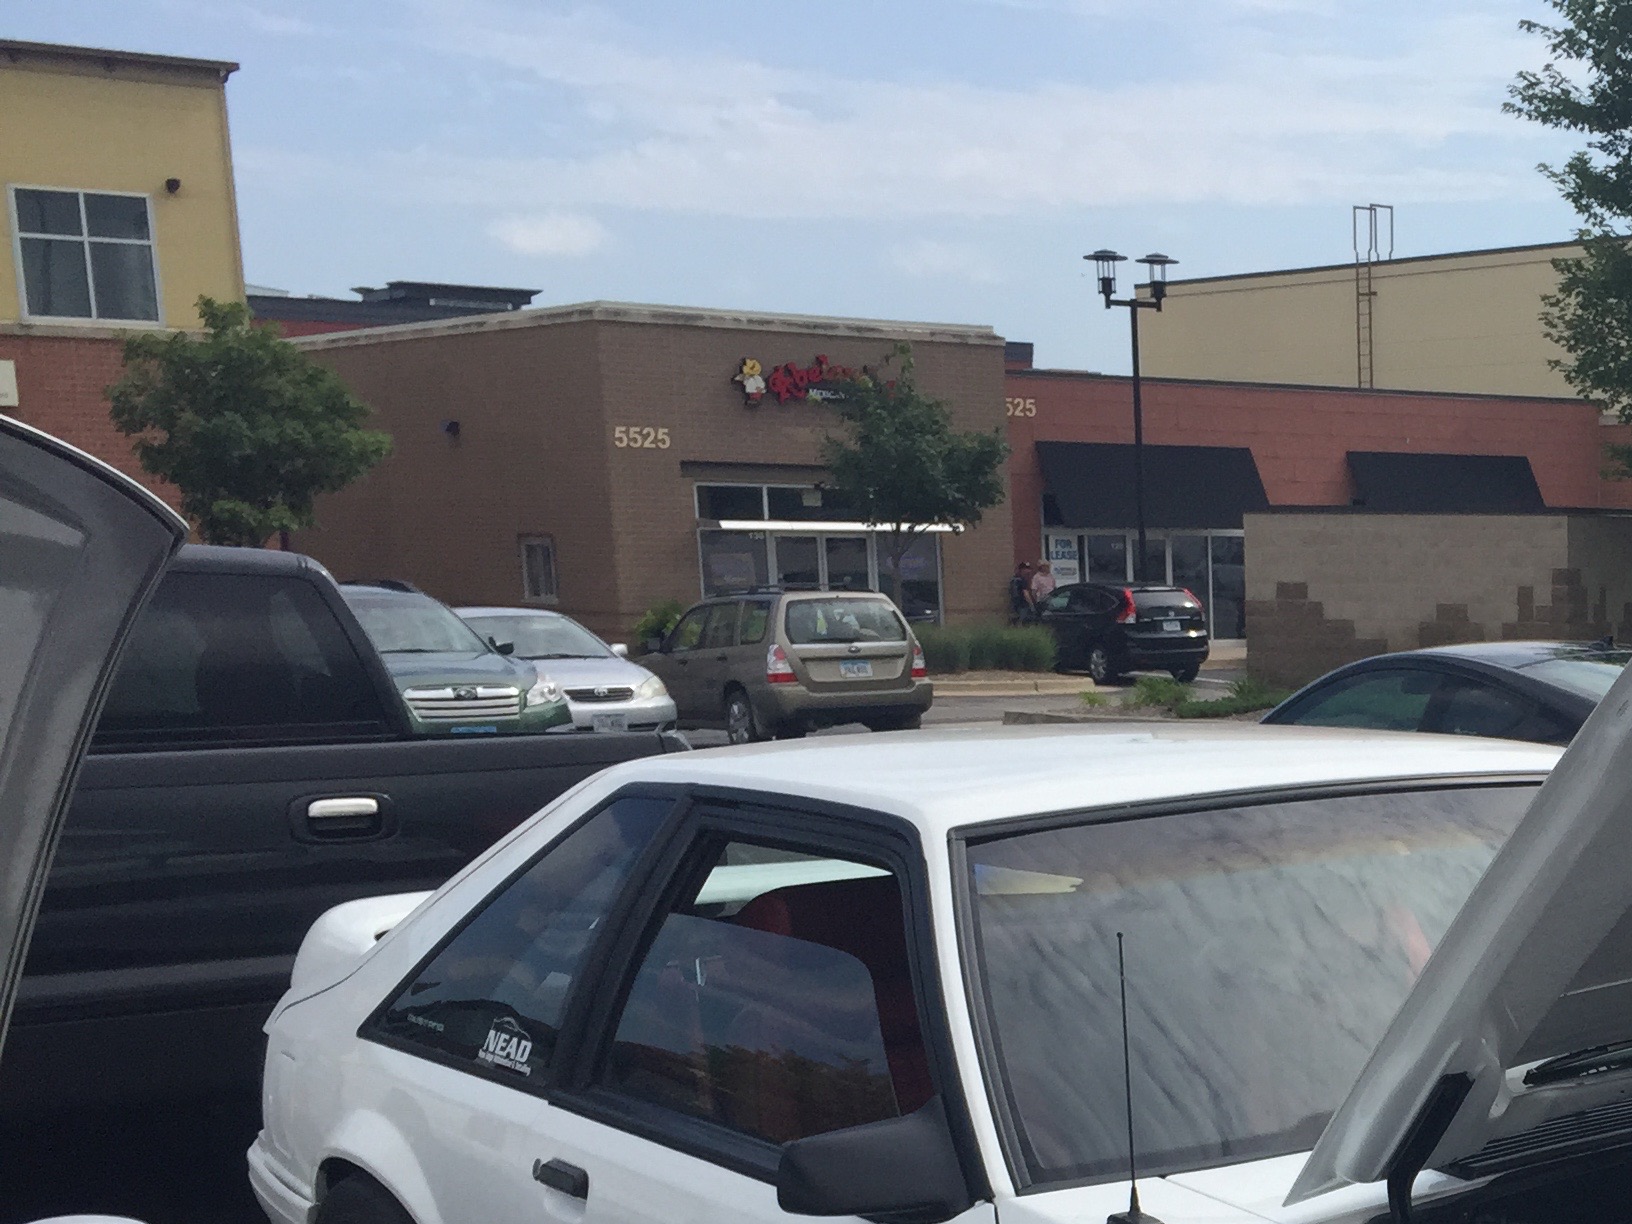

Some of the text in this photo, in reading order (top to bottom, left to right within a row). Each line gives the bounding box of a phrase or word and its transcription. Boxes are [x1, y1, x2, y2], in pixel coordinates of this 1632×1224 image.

[614, 426, 671, 449] 5525
[1055, 539, 1072, 549] FOR
[1050, 550, 1078, 560] LEASE
[482, 1029, 533, 1063] NEAD
